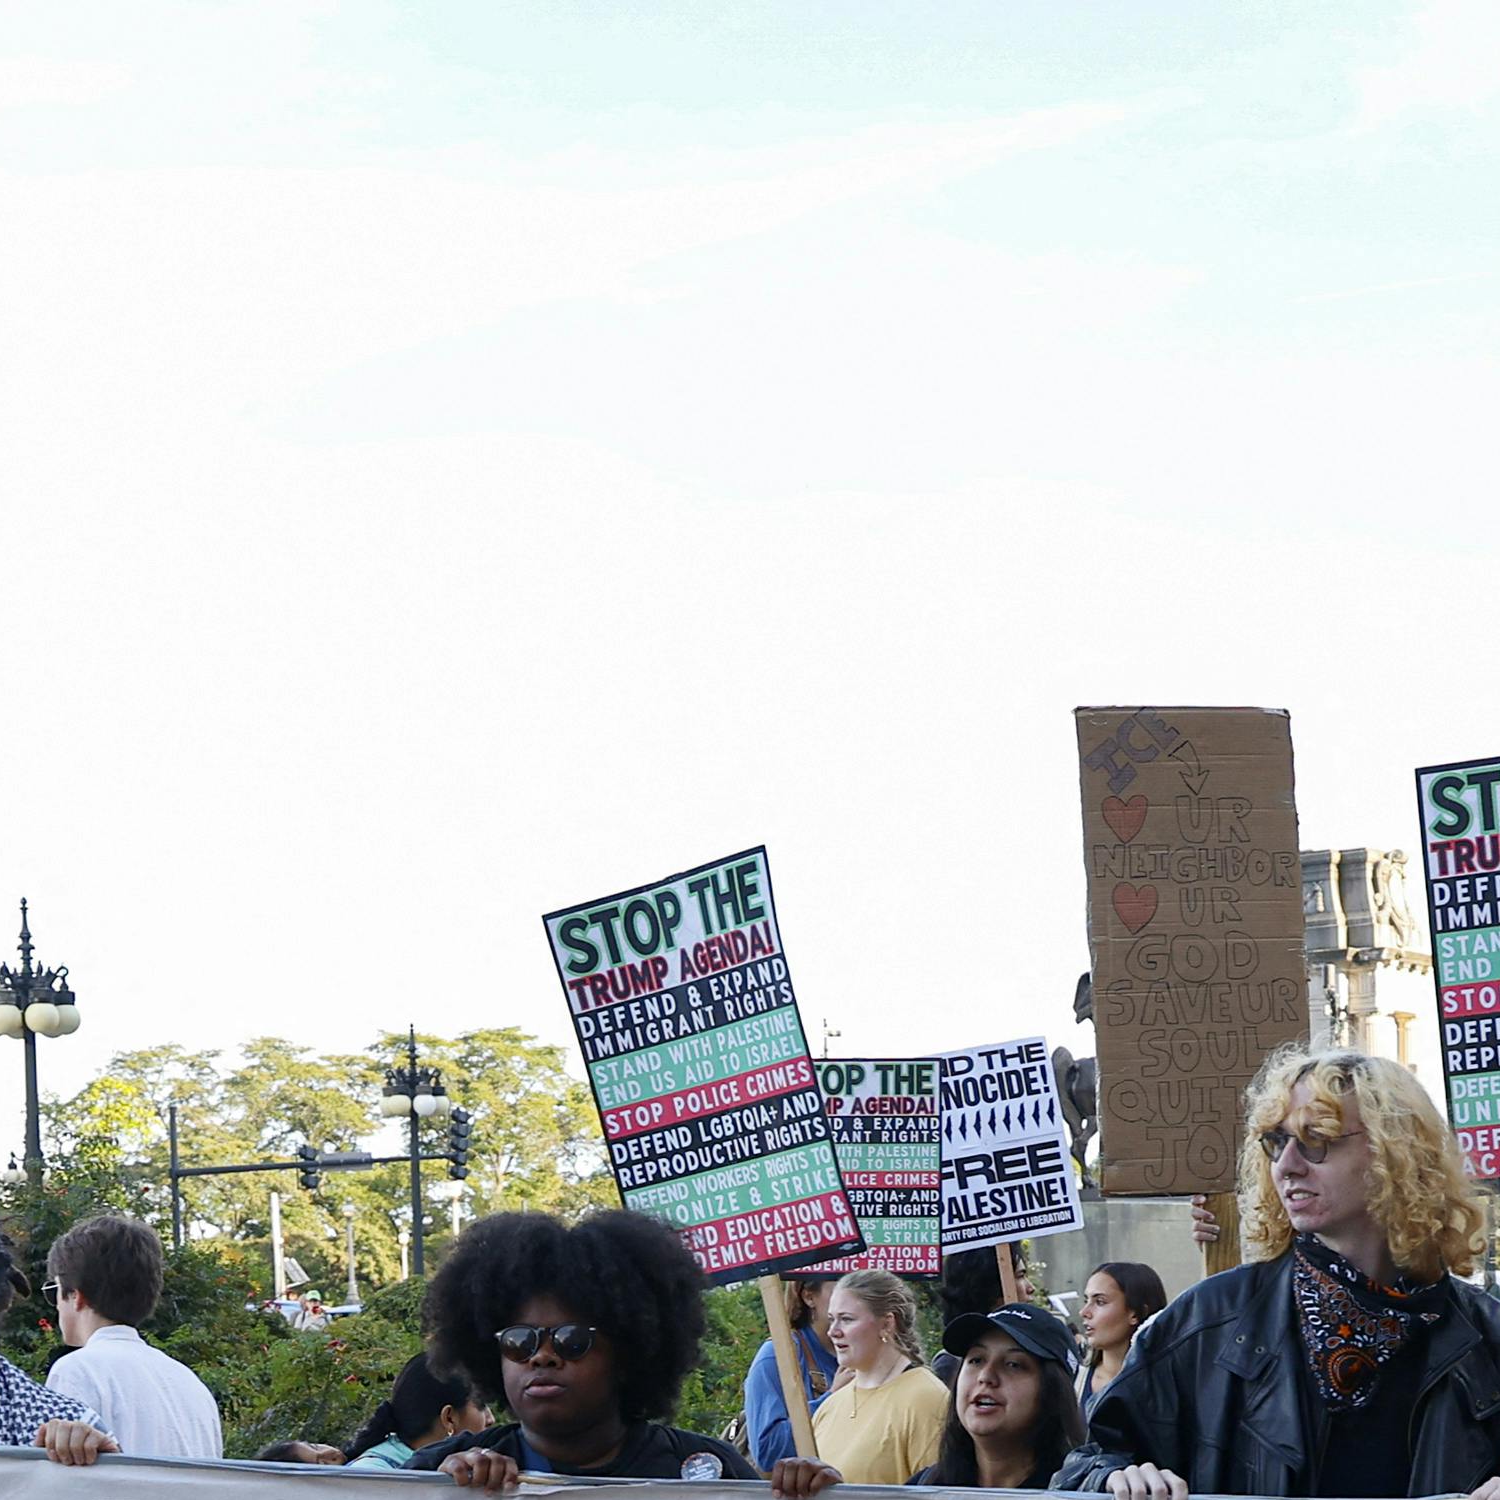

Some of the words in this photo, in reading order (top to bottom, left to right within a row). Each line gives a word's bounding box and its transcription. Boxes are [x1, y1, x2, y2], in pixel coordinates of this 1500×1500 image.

[1084, 706, 1179, 795] ICE
[1175, 794, 1252, 844] UR
[1094, 844, 1296, 888] NEIGHBOR
[557, 889, 683, 976] STOP
[686, 859, 766, 937] THE
[1179, 886, 1242, 926] UR
[568, 956, 669, 1012] TRUMP
[679, 919, 776, 983] AGENDA!
[1125, 932, 1260, 983] GOD
[1442, 957, 1492, 984] END
[577, 989, 678, 1038] DEFEND
[686, 982, 702, 1007] &
[708, 957, 788, 1001] EXPAND
[583, 1003, 717, 1061] IMMIGRANT
[723, 981, 794, 1022] RIGHTS
[1106, 978, 1233, 1026] SAVE
[1240, 977, 1300, 1025] UR
[593, 1048, 663, 1086] STAND
[668, 1034, 713, 1065] WITH
[715, 1011, 797, 1052] PALESTINE
[599, 1078, 643, 1107] END
[648, 1069, 676, 1093] US
[683, 1058, 715, 1084] AID
[719, 1051, 742, 1075] TO
[744, 1035, 803, 1068] ISRAEL
[978, 1042, 1046, 1070] THE
[1138, 1027, 1274, 1077] SOUL
[603, 1099, 666, 1134] STOP
[672, 1079, 741, 1116] POLICE
[744, 1060, 812, 1097] CRIMES
[941, 1065, 1050, 1111] NOCIDE!
[1107, 1074, 1254, 1125] QUIT
[611, 1124, 694, 1164] DEFEND
[698, 1101, 780, 1142] LGBTQIA+
[780, 1091, 821, 1121] AND
[617, 1133, 761, 1187] REPRODUCTIVE
[764, 1116, 827, 1151] RIGHTS
[624, 1179, 690, 1211] DEFEND
[691, 1161, 764, 1195] WORKERS'
[764, 1150, 809, 1177] RIGHTS
[812, 1144, 833, 1166] TO
[748, 1185, 763, 1206] &
[770, 1166, 840, 1201] STRIKE
[942, 1177, 1070, 1225] ALESTINE!
[724, 1199, 826, 1242] EDUCATION
[829, 1194, 848, 1218] &
[763, 1216, 855, 1256] FREEDOM
[942, 1226, 962, 1243] ARTY
[964, 1224, 978, 1238] FOR
[978, 1219, 1019, 1237] SOCIALISM
[1027, 1210, 1072, 1228] LIBERATION
